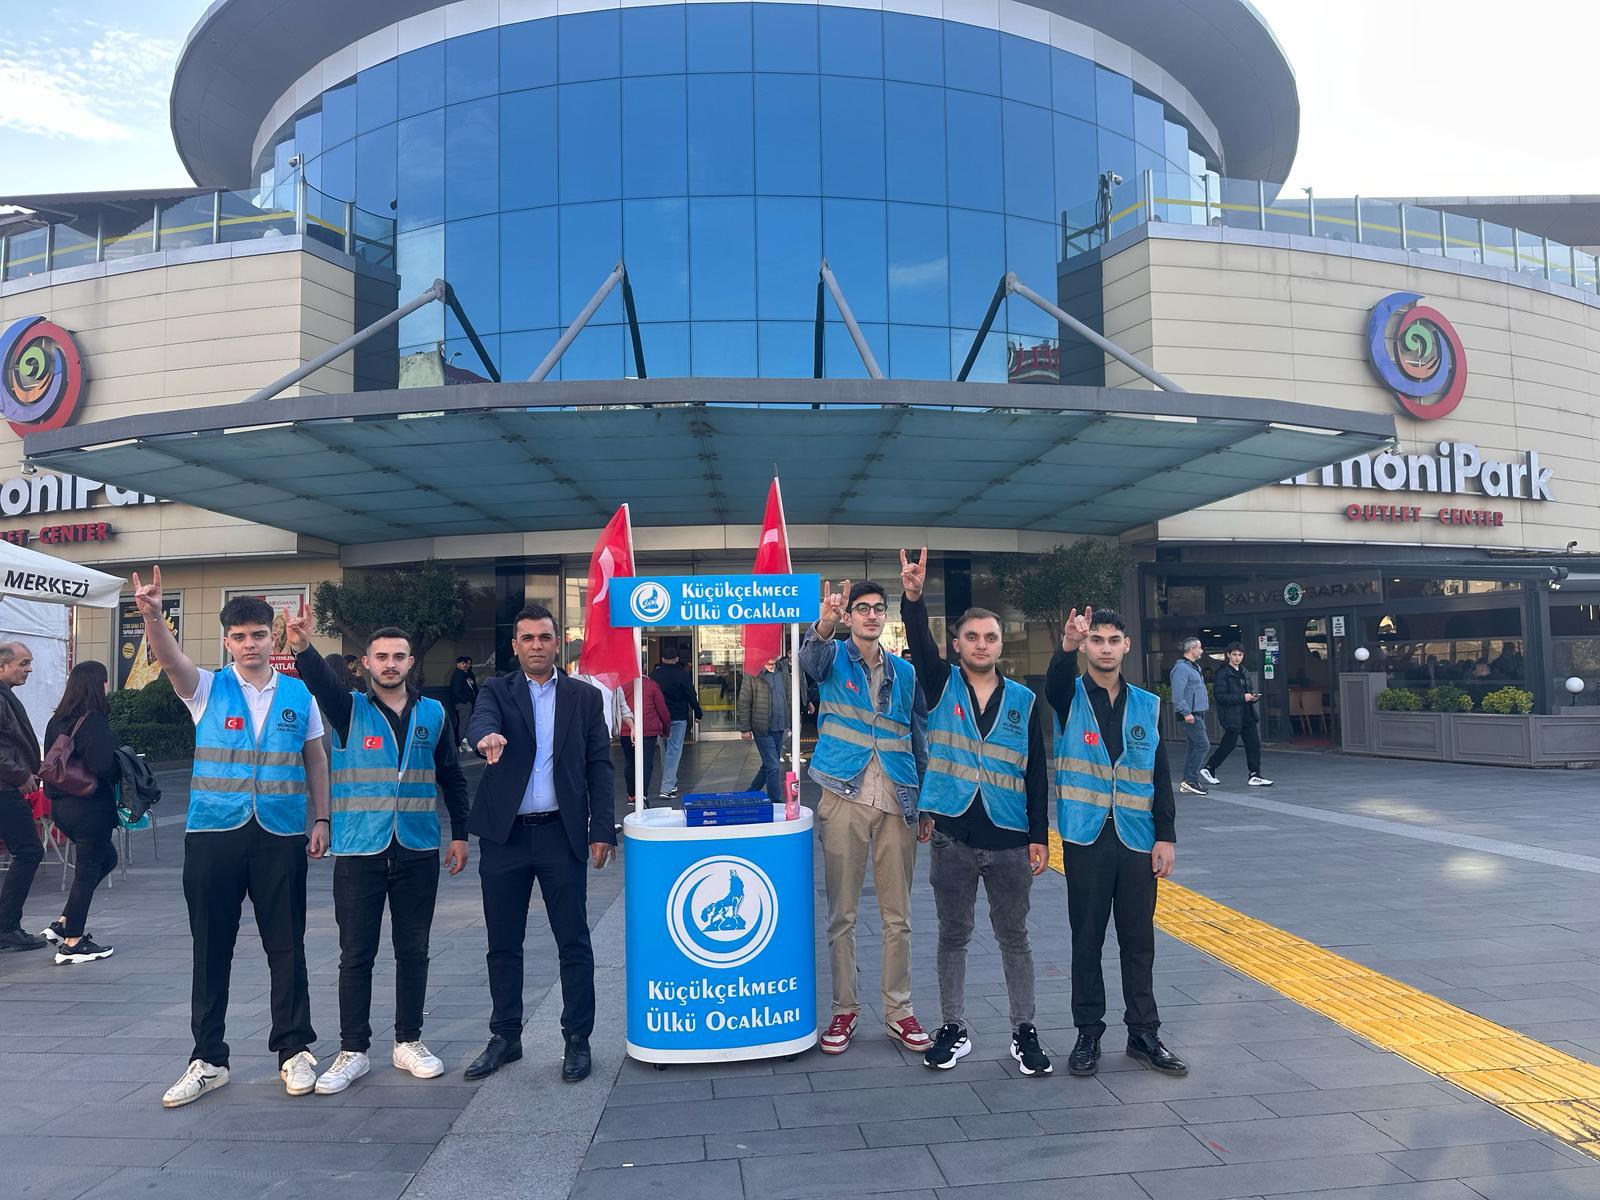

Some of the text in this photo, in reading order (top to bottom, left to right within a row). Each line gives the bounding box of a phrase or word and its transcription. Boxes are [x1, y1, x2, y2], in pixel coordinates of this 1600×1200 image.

[1280, 440, 1554, 501] moniPark
[1345, 503, 1504, 527] OUTLET CENTER
[39, 522, 108, 545] CENTER
[4, 569, 90, 598] MERKEZİ
[680, 601, 721, 621] Ülkü
[646, 1007, 696, 1033] Ülkü
